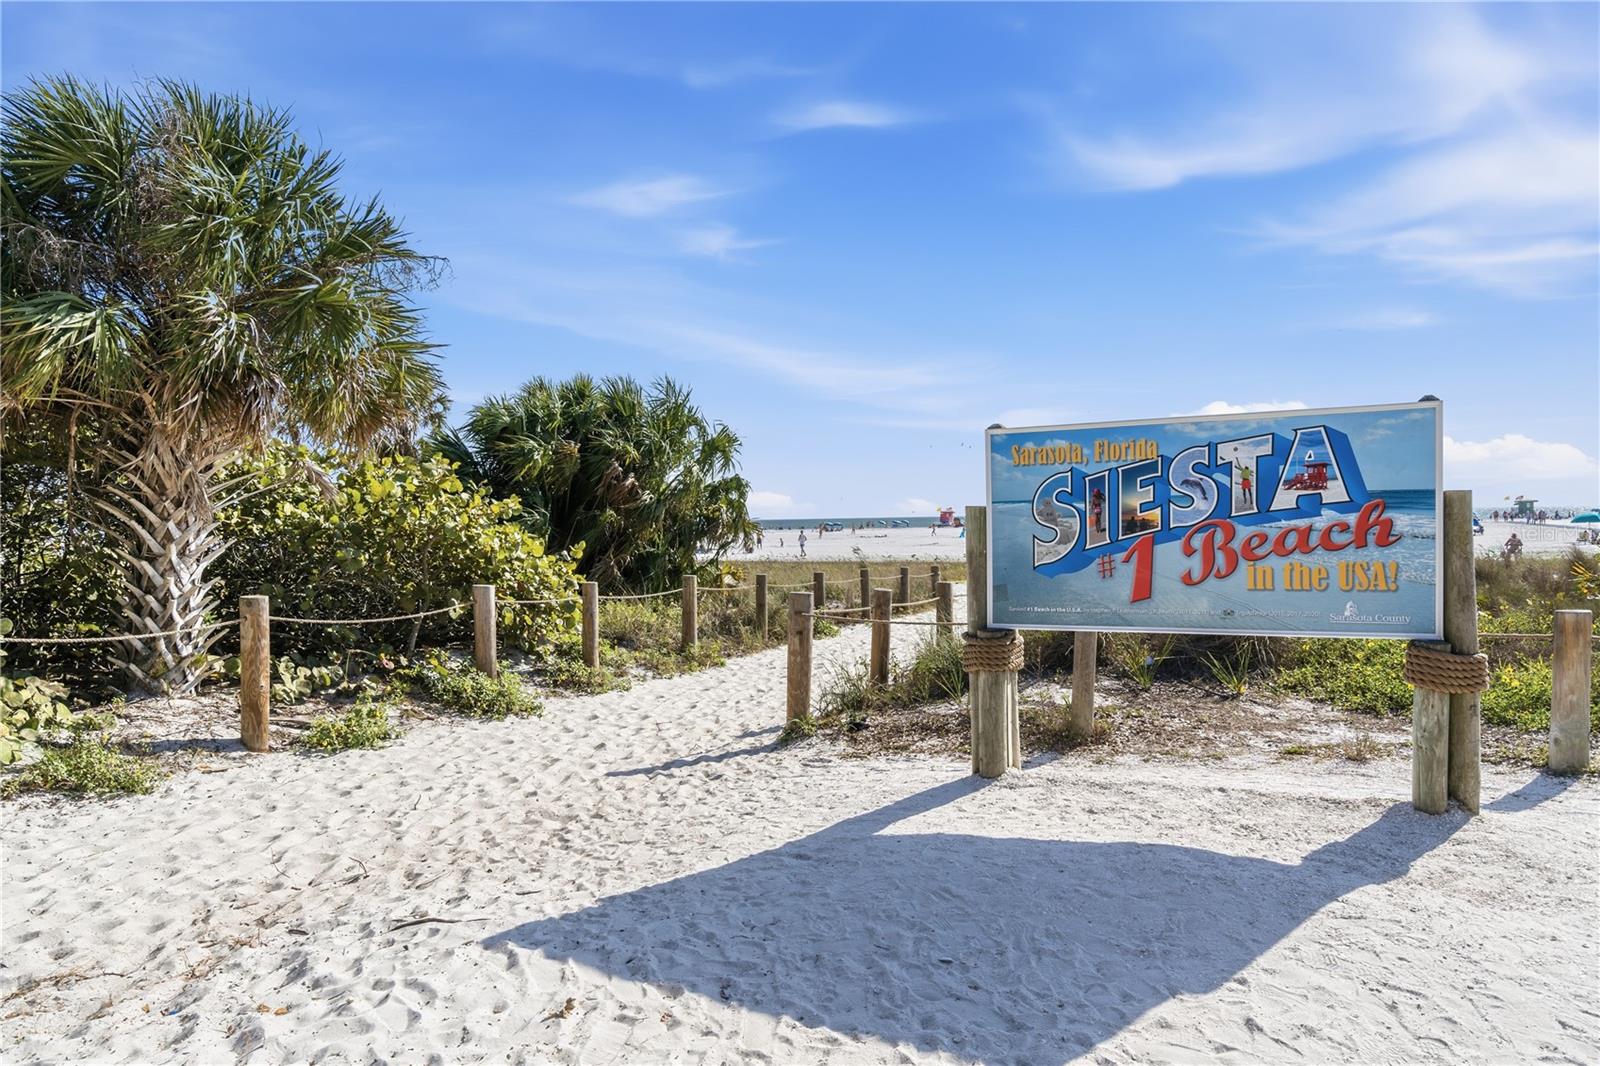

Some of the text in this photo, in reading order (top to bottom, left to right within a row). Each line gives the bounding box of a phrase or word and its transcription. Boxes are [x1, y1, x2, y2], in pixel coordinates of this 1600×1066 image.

[1011, 438, 1160, 466] Sarasota, Florida
[1032, 424, 1356, 571] SIESTA
[1097, 498, 1403, 604] #1 Beach
[1247, 558, 1400, 593] in the USA!
[1329, 613, 1374, 624] Sarasota
[1376, 613, 1412, 625] County
